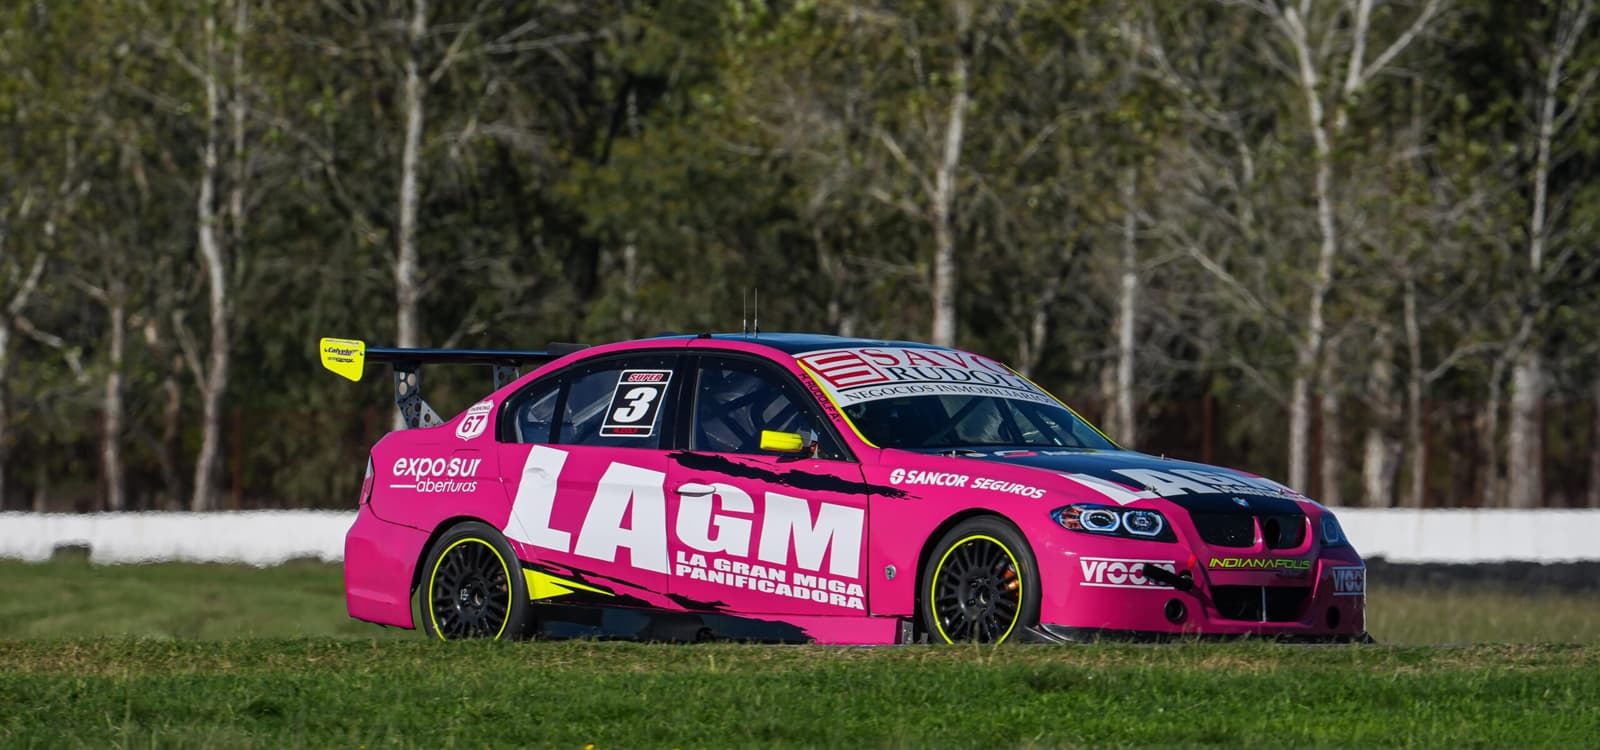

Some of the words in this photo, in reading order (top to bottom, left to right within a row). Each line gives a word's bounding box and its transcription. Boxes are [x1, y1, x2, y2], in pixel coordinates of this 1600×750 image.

[627, 373, 664, 382] SUPER
[612, 387, 658, 423] 3
[844, 384, 934, 402] NEGOCIOS
[462, 414, 485, 433] 67
[416, 478, 478, 493] aberturas
[905, 469, 970, 488] SANCOR
[970, 477, 1047, 499] SEGUROS
[502, 444, 865, 580] LAGM
[676, 550, 708, 568] LA
[713, 558, 787, 582] GRAN
[793, 572, 865, 598] MIGA
[1208, 557, 1311, 570] INDIANAPOLIS
[676, 563, 865, 610] PANIFICADORA
